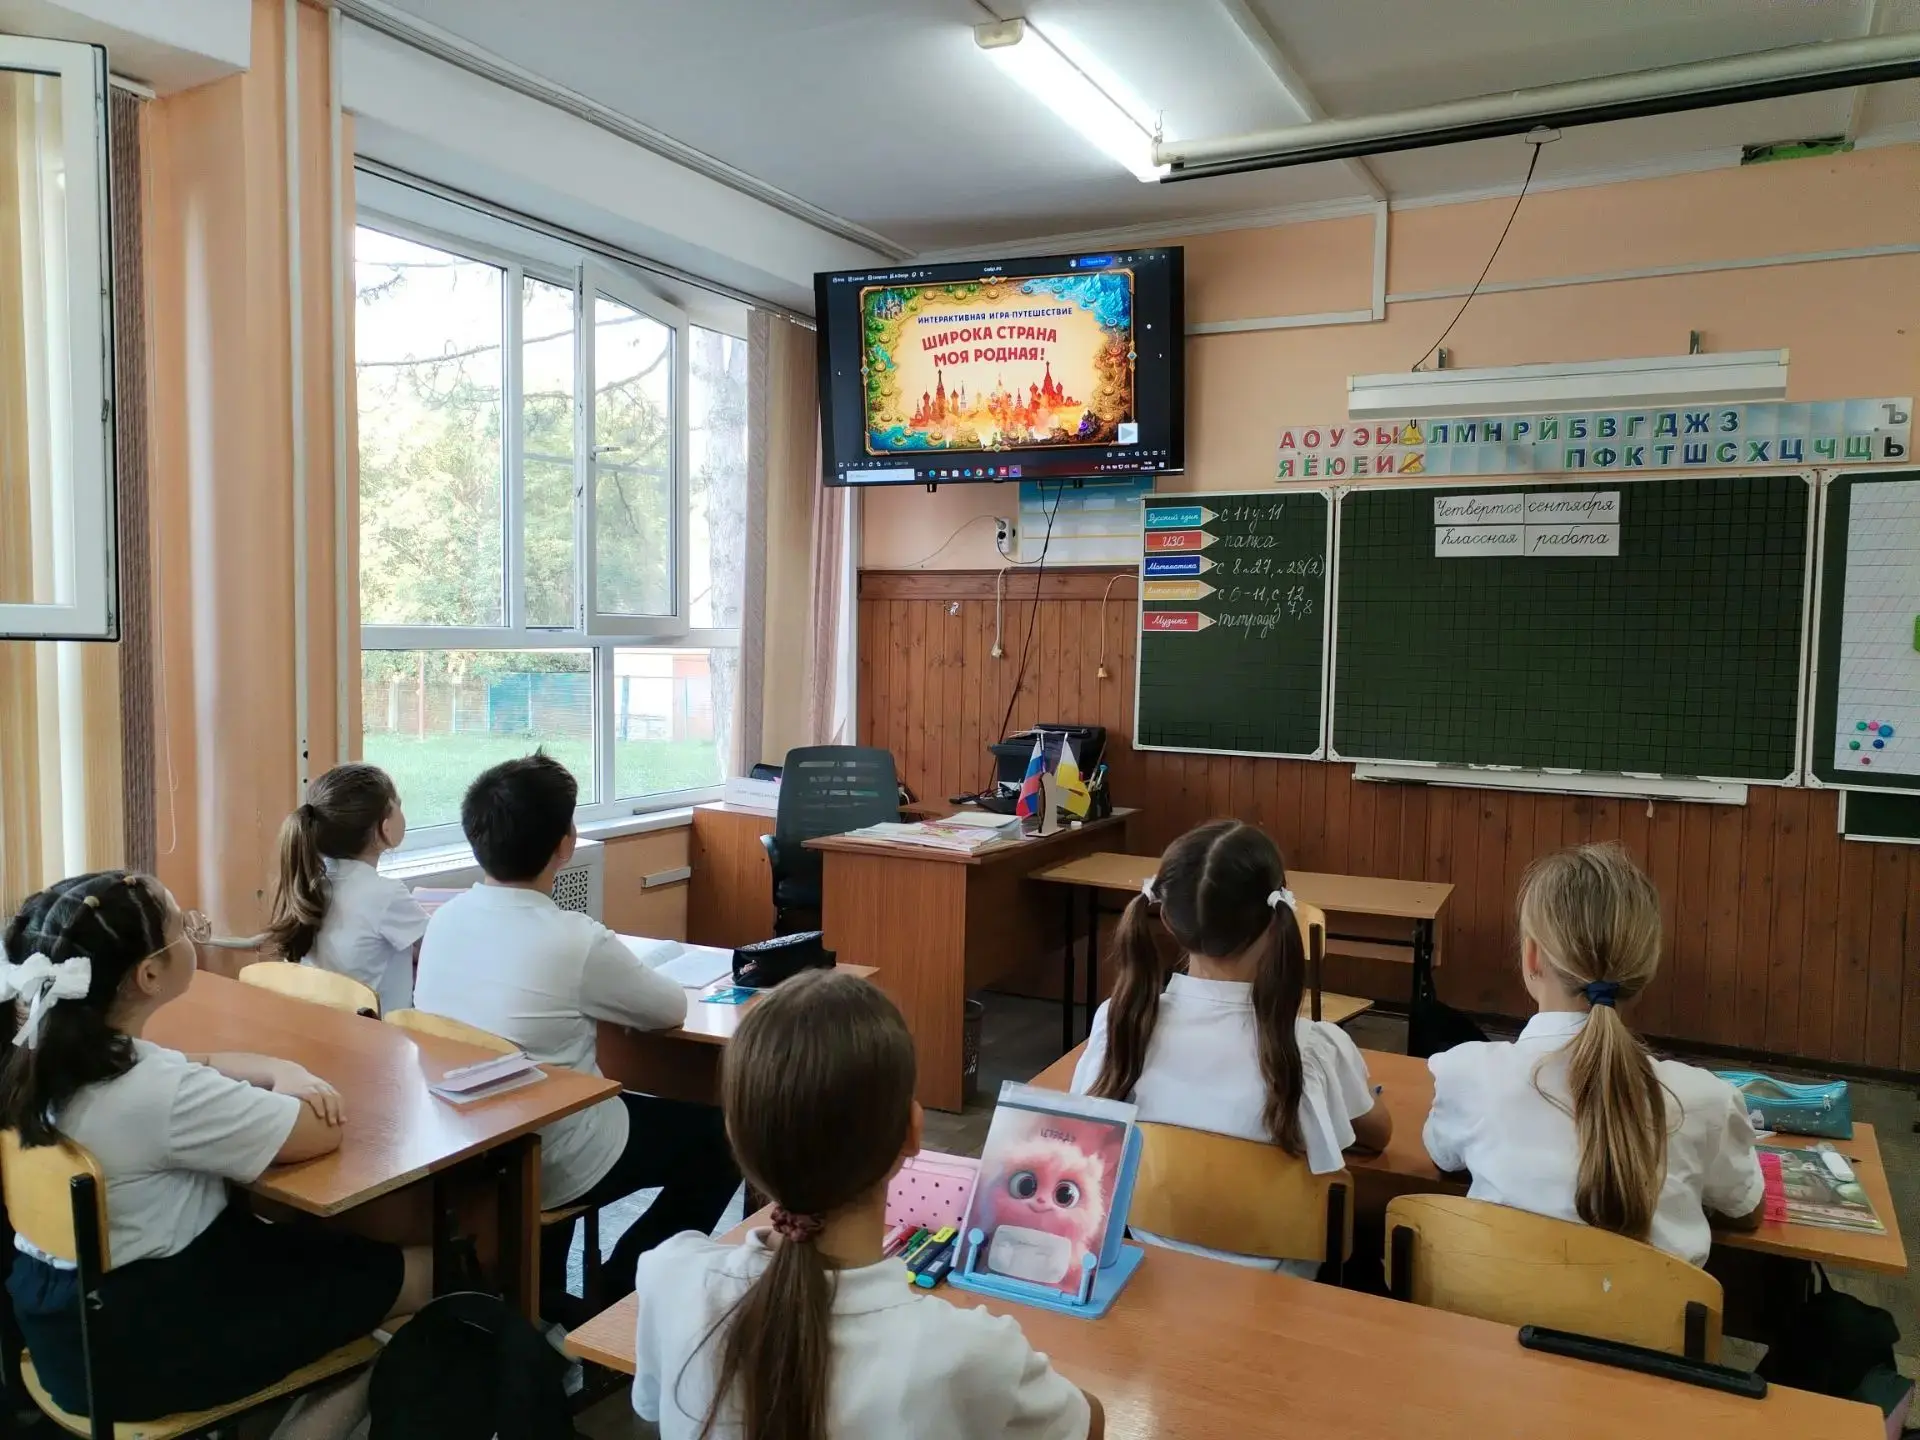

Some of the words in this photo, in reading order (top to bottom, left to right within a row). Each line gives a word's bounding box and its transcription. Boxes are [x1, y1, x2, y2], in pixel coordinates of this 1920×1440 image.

[918, 313, 986, 324] ИНТЕРАКТИВНАЯ
[922, 326, 993, 351] ШИРОКА
[996, 325, 1057, 343] СТРАНА
[934, 350, 969, 367] МОЯ
[974, 347, 1045, 363] РОДНАЯ!
[1279, 431, 1296, 449] А
[1303, 430, 1321, 448] О
[1329, 428, 1345, 448] У
[1352, 428, 1370, 446] Э
[1428, 424, 1448, 444] Л
[1455, 423, 1476, 443] М
[1483, 422, 1502, 442] Н
[1512, 421, 1530, 441] Р
[1538, 416, 1558, 441] Й
[1568, 418, 1587, 439] Б
[1597, 417, 1617, 438] В
[1626, 416, 1644, 437] Г
[1653, 413, 1678, 438] Д
[1684, 412, 1710, 433] Ж
[1719, 410, 1738, 432] З
[1881, 403, 1908, 424] Ъ
[1277, 459, 1294, 478] Я
[1303, 454, 1318, 476] Ё
[1325, 457, 1346, 476] Ю
[1353, 456, 1368, 474] Е
[1375, 455, 1393, 474] И
[1565, 448, 1586, 468] П
[1592, 447, 1617, 466] Ф
[1624, 446, 1644, 466] К
[1654, 445, 1675, 465] Т
[1683, 443, 1708, 463] Ш
[1715, 442, 1738, 463] С
[1747, 440, 1771, 462] Х
[1778, 438, 1803, 463] Ц
[1813, 437, 1836, 459] Ч
[1843, 436, 1872, 460] Щ
[1883, 436, 1904, 457] Ь
[1528, 491, 1615, 519] сентября
[1162, 535, 1185, 547] ИЗО
[1225, 533, 1281, 548] папка
[1441, 528, 1518, 545] Классная
[1532, 525, 1610, 552] работа
[1148, 562, 1197, 571] Математика
[1152, 615, 1188, 628] Музыка
